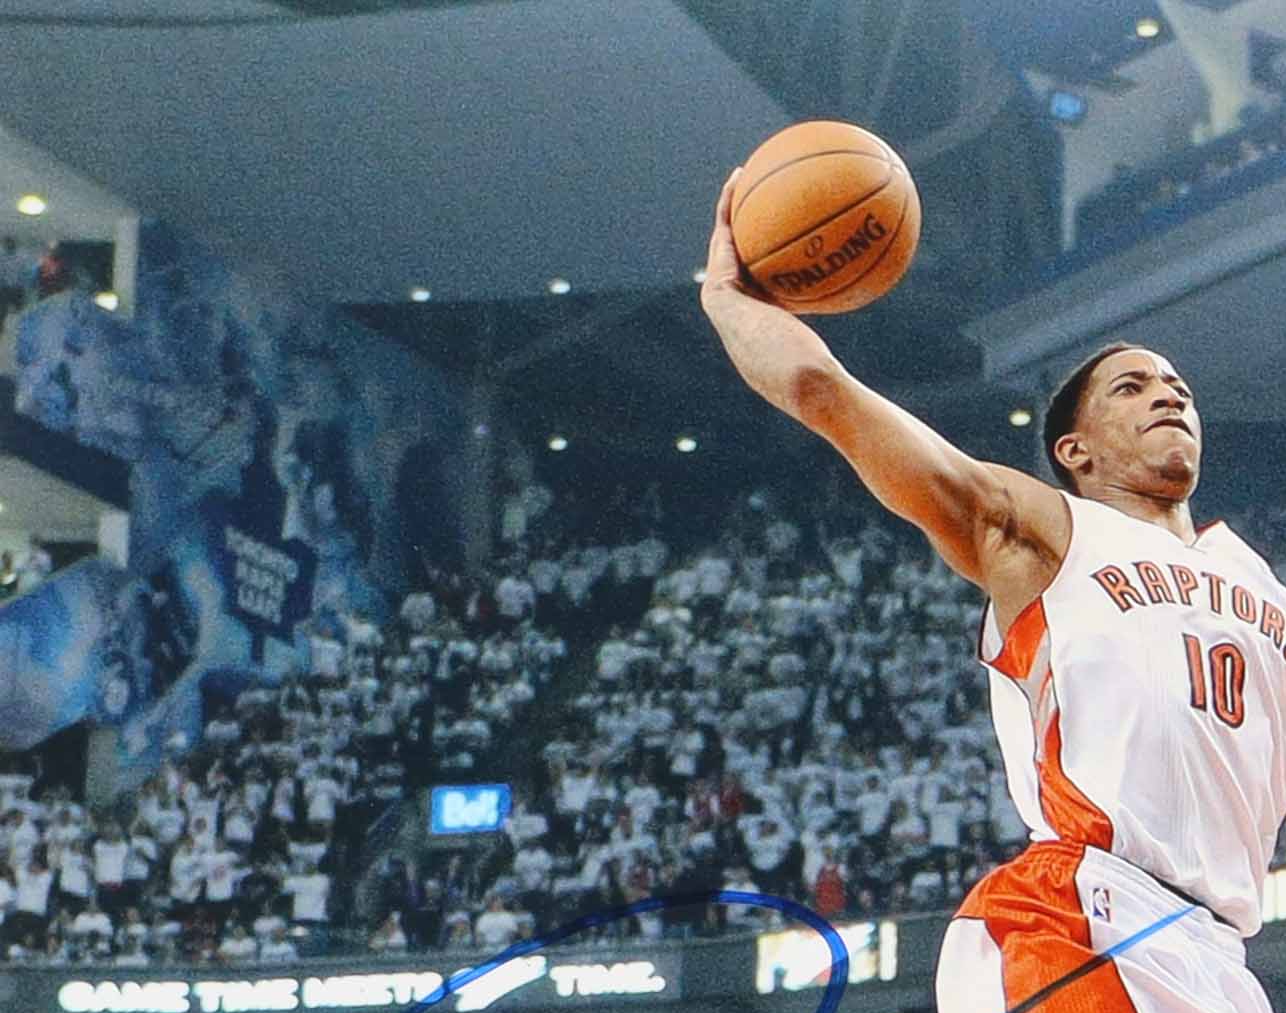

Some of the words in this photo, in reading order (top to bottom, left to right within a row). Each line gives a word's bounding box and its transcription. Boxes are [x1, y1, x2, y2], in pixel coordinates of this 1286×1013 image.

[770, 213, 888, 294] SPALDING
[1181, 632, 1246, 729] 10
[57, 980, 191, 1013] GAME
[192, 977, 299, 1013] TIME
